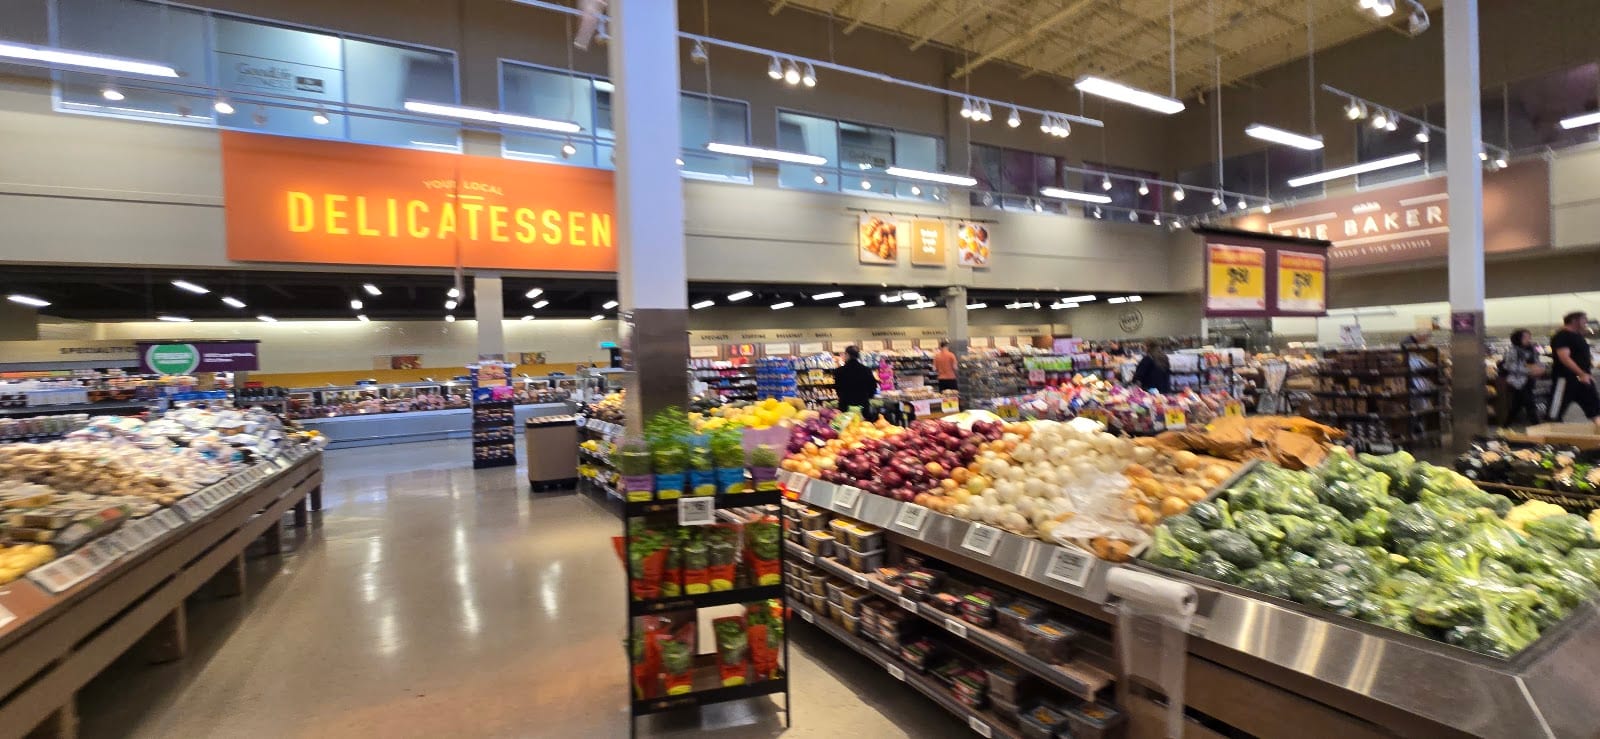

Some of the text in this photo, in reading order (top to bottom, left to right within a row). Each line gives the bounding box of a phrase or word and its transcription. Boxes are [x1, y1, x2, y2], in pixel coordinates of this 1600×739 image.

[463, 181, 504, 195] LOCAL
[286, 190, 612, 248] DELICATESSEN
[1344, 205, 1443, 237] BAKER
